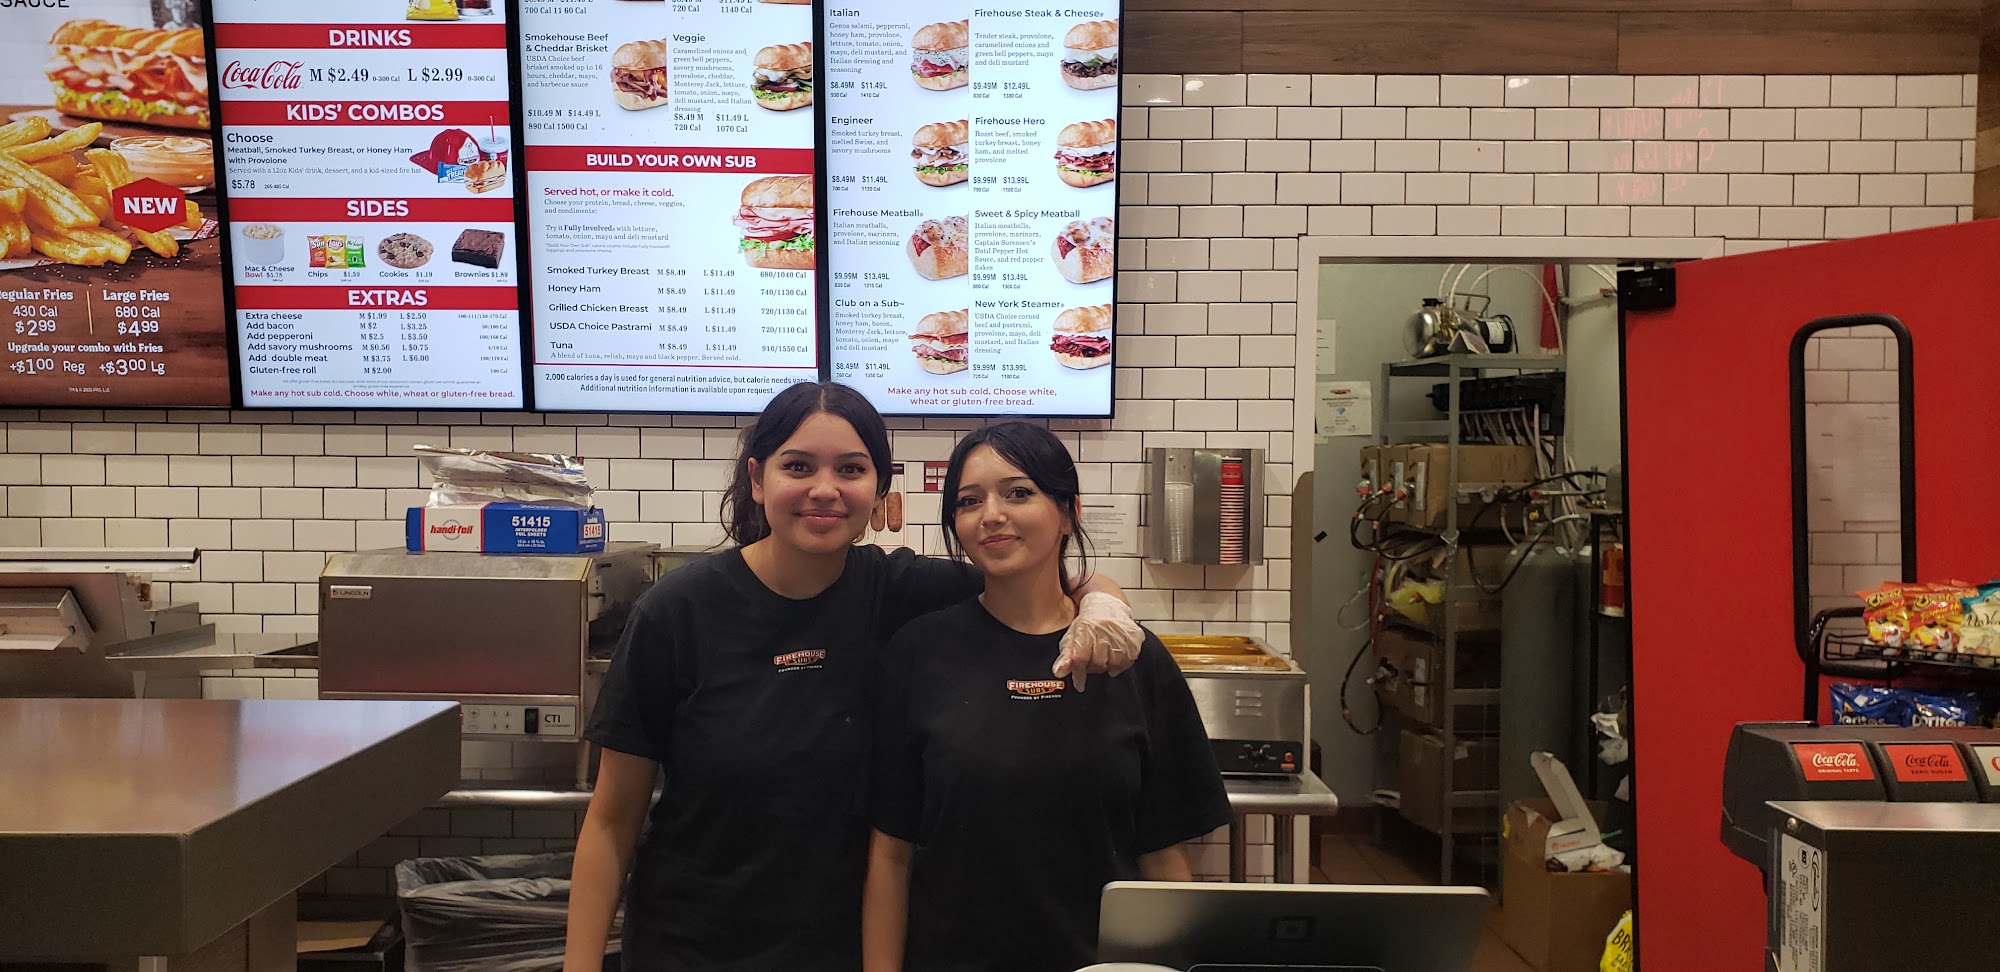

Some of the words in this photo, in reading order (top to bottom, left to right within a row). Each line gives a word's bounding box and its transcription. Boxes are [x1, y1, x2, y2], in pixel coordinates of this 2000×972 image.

[975, 9, 1022, 17] Firehouse
[329, 29, 412, 47] DRINKS
[673, 34, 705, 43] Veggie
[576, 44, 608, 52] Brisket
[222, 61, 304, 89] Coca-Cola
[310, 69, 323, 81] M
[328, 67, 368, 83] $2.49
[408, 69, 417, 81] L
[422, 67, 462, 83] $2.99
[348, 103, 445, 121] COMBOS
[832, 116, 873, 125] Engineer
[227, 133, 273, 142] Choose
[227, 147, 264, 155] Meatball,
[367, 147, 391, 155] Honey
[587, 154, 633, 167] BUILD
[636, 154, 679, 168] YOUR
[682, 155, 721, 168] OWN
[724, 155, 757, 168] SUB
[232, 180, 255, 189] $5.78
[580, 188, 598, 197] hot,
[613, 188, 640, 196] make
[643, 188, 649, 196] it
[123, 197, 177, 214] NEW
[347, 199, 409, 217] SIDES
[1015, 210, 1038, 219] Spicy
[587, 267, 618, 276] Turkey
[0, 287, 41, 302] egular
[42, 288, 74, 301] Fries
[549, 285, 577, 293] Honey
[103, 290, 137, 302] Large
[139, 289, 170, 302] Fries
[348, 289, 428, 306] EXTRAS
[13, 305, 36, 316] 430
[39, 306, 58, 318] Cal
[114, 305, 139, 319] 680
[141, 306, 160, 319] Cal
[578, 322, 609, 330] Choice
[268, 332, 312, 341] pepperoni
[7, 342, 49, 354] Upgrade
[52, 344, 76, 353] your
[77, 341, 111, 353] combo
[113, 342, 137, 353] with
[138, 343, 164, 353] Fries
[63, 360, 86, 376] Reg
[151, 361, 166, 376] Lg
[567, 374, 594, 382] calories
[601, 374, 612, 383] day
[511, 516, 550, 527] 51415
[431, 525, 473, 534] handi-foil
[584, 526, 601, 536] 51415
[776, 651, 825, 665] FIREHOUSE
[1009, 681, 1063, 691] FIREHOUSE
[544, 714, 561, 723] CTI
[1813, 753, 1858, 767] Coca-Cola
[1905, 754, 1950, 767] Coca-Cola
